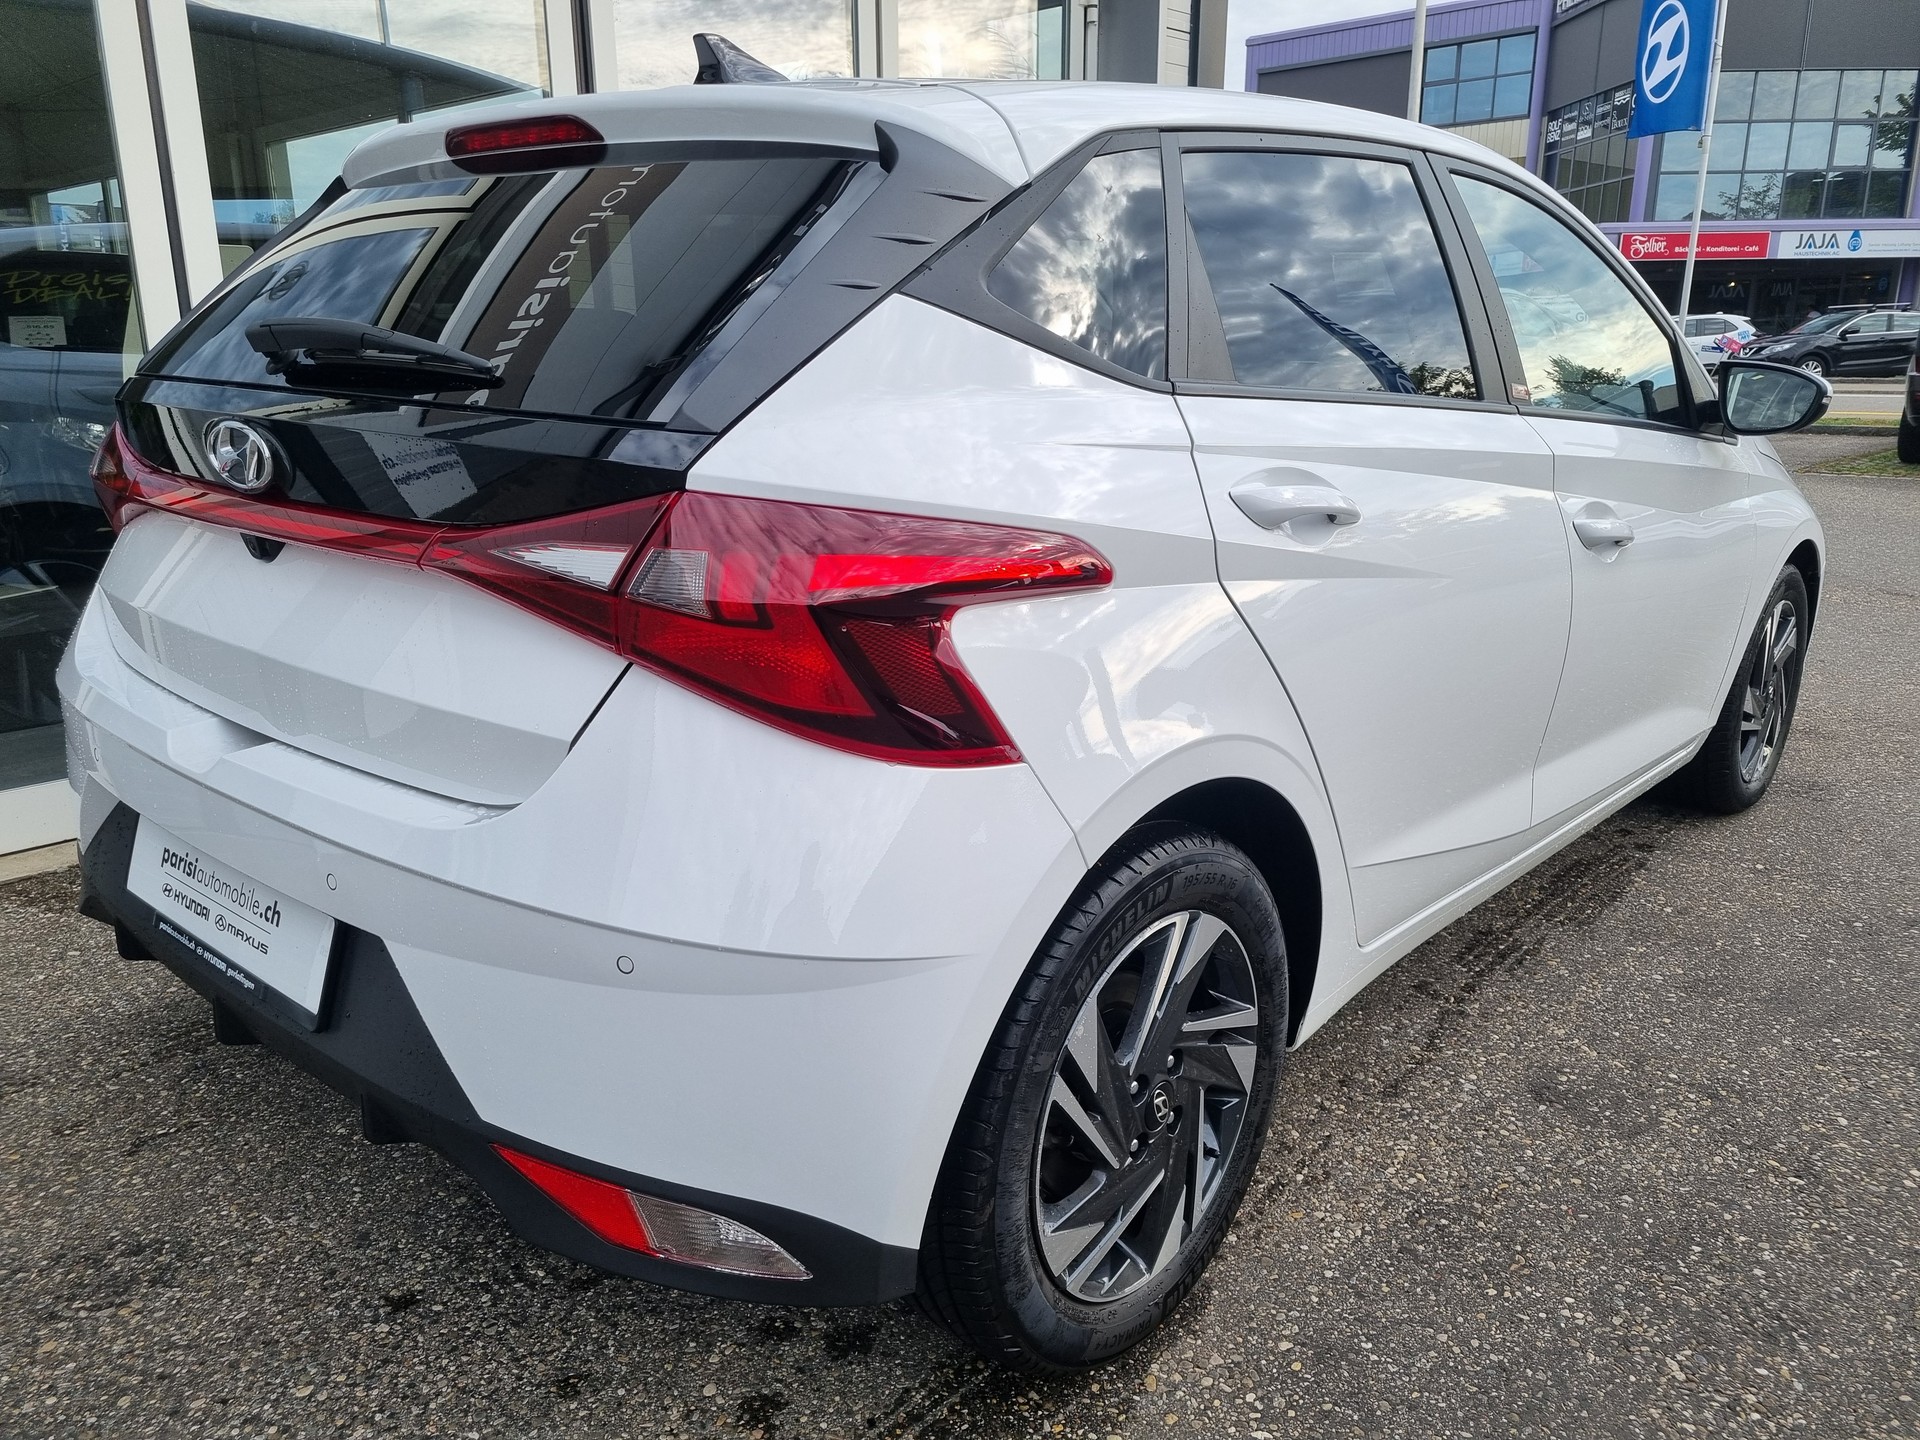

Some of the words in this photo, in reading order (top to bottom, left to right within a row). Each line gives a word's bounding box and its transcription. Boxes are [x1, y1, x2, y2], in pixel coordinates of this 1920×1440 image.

[1630, 235, 1669, 258] Felber
[1744, 244, 1759, 252] Café
[1795, 233, 1840, 249] JAJA
[0, 270, 129, 289] Preis
[3, 281, 133, 304] DEAL!
[1708, 285, 1745, 298] JAJA
[161, 847, 281, 928] parisiautomobile.ch
[1183, 873, 1218, 889] 195/55
[1217, 874, 1226, 886] R
[1227, 877, 1238, 890] 16
[173, 890, 211, 922] HYUNDAI
[226, 923, 269, 955] MAXUS
[1074, 881, 1169, 1000] MICHELIN
[203, 950, 227, 972] HYUNDAI
